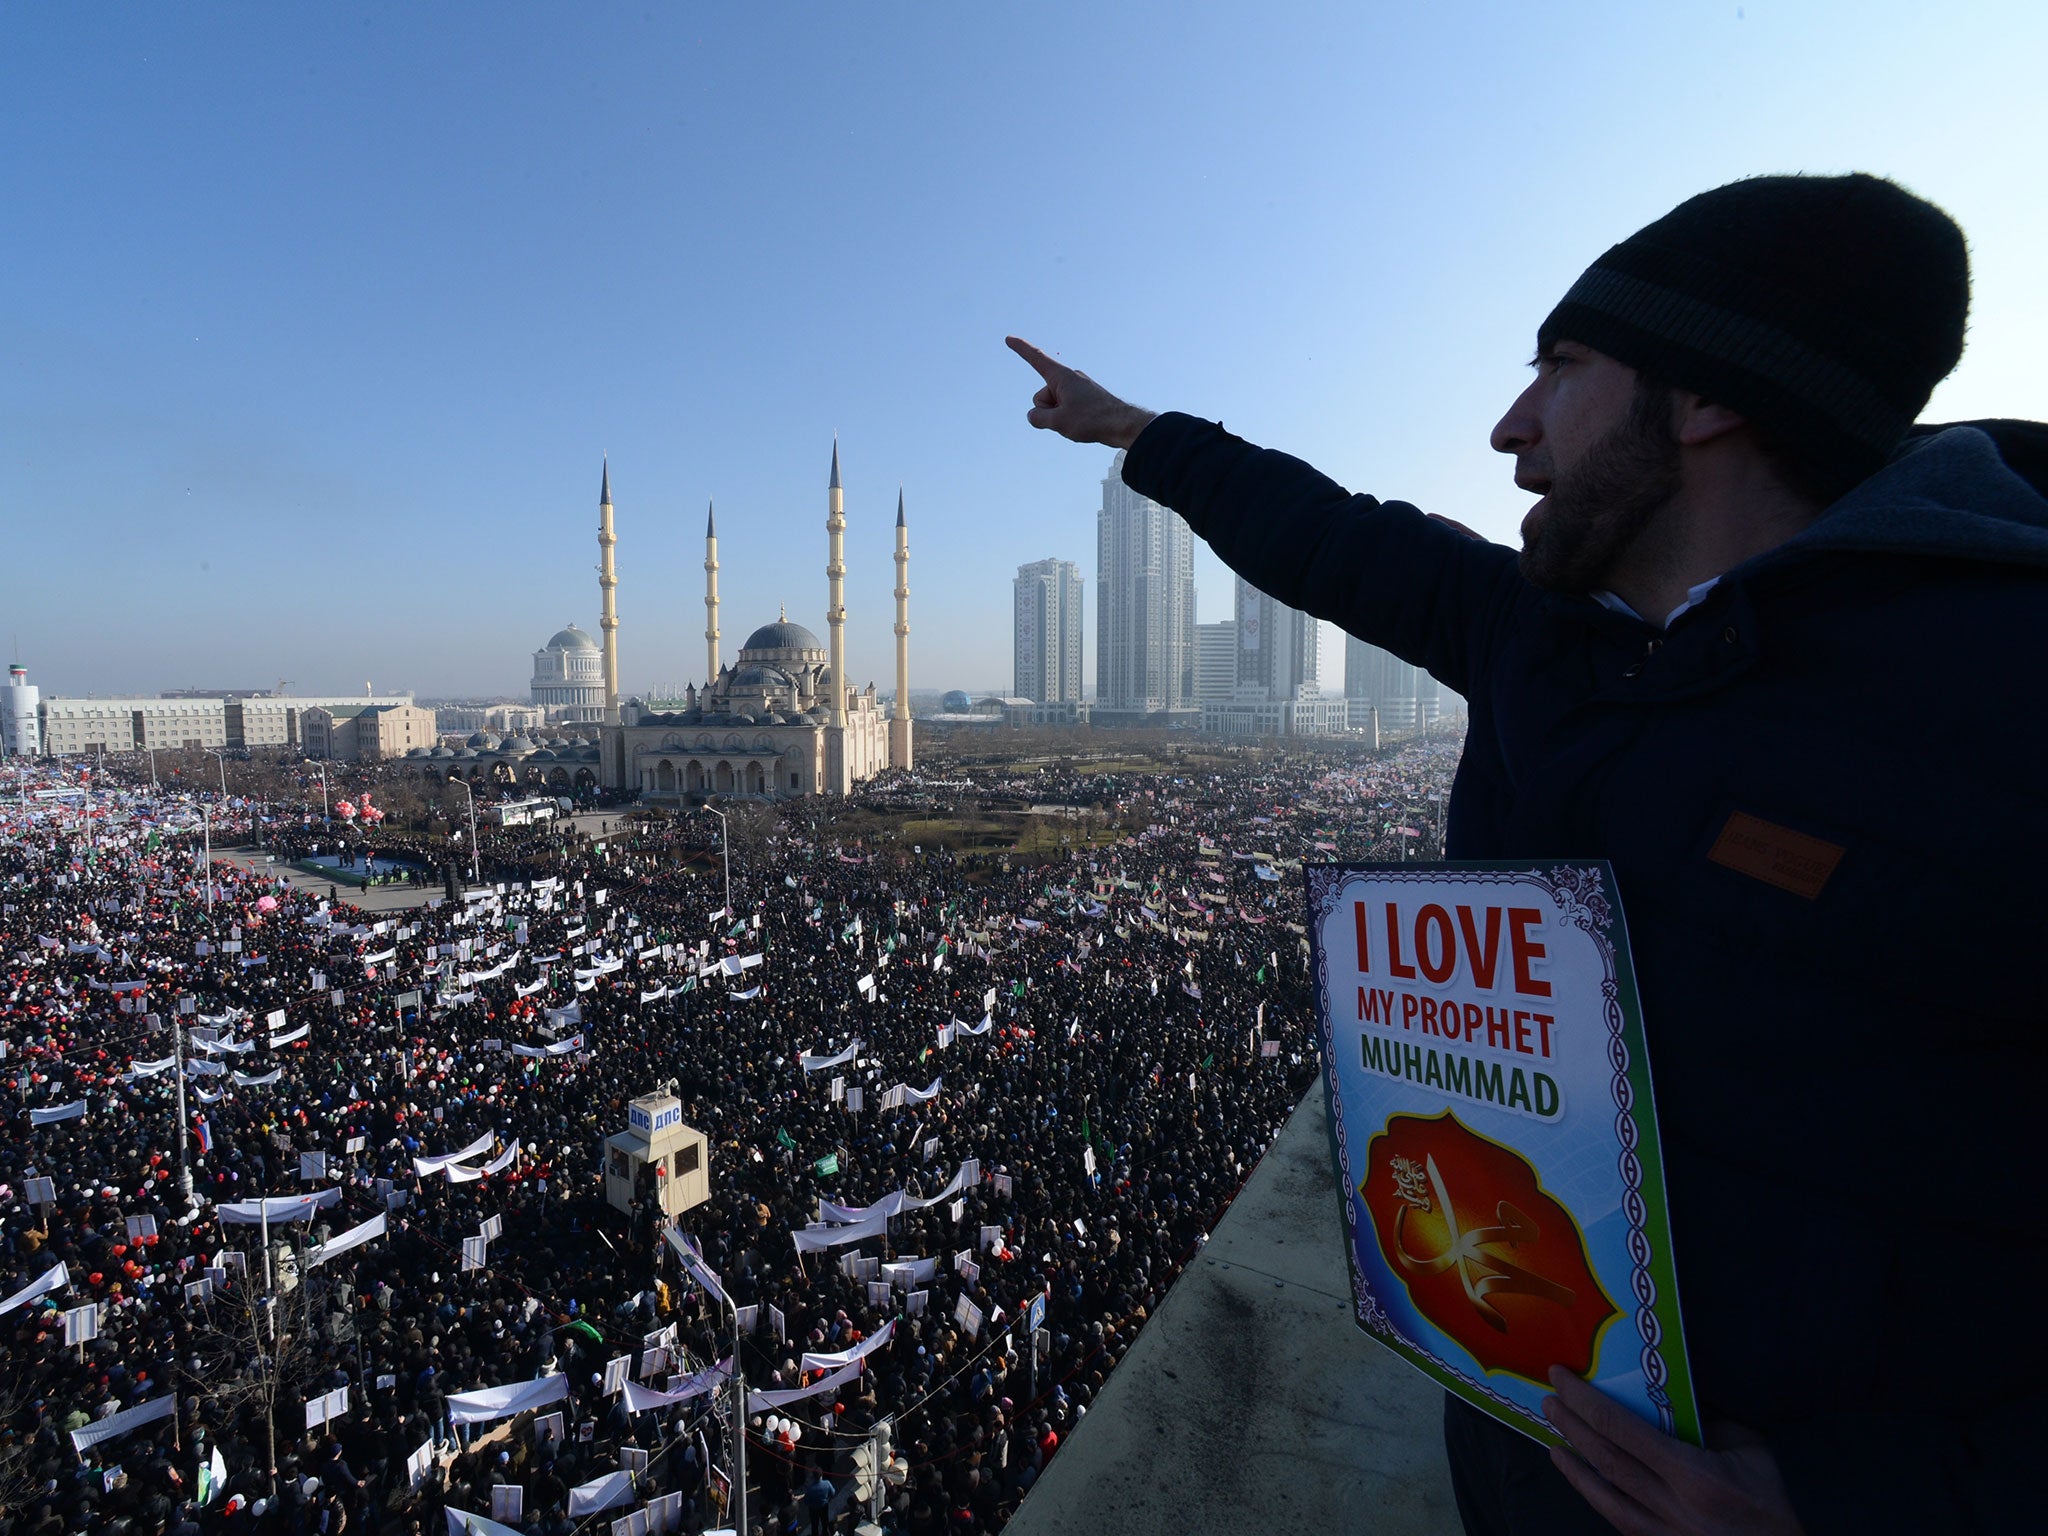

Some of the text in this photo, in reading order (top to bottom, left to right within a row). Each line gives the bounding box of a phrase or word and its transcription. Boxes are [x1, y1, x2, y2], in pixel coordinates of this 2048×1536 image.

[1354, 901, 1552, 997] I LOVE
[1358, 986, 1555, 1058] MY PROPHET
[1361, 1033, 1559, 1117] MUHAMMAD
[631, 1109, 650, 1131] ДПС
[654, 1107, 680, 1131] ДПС
